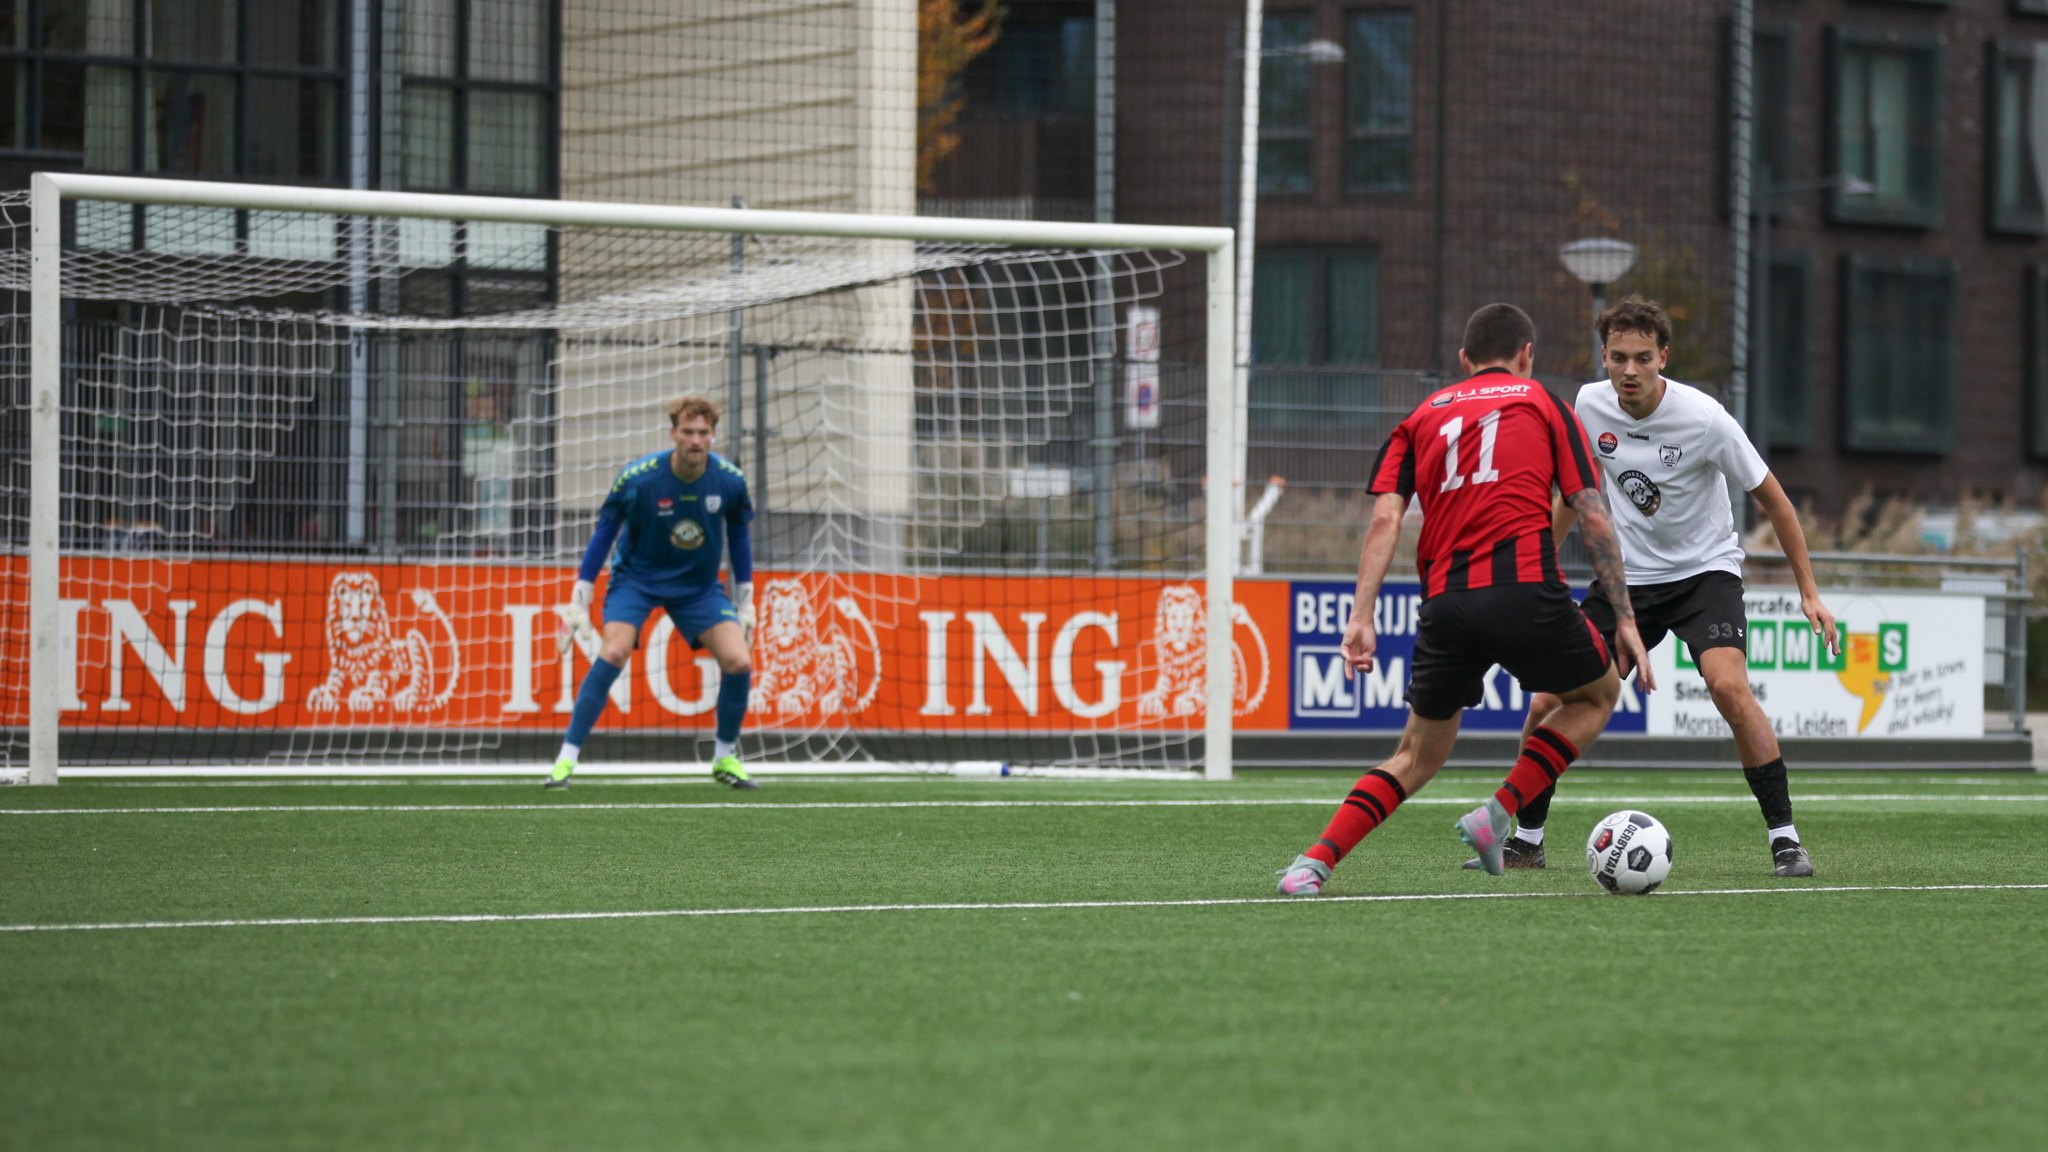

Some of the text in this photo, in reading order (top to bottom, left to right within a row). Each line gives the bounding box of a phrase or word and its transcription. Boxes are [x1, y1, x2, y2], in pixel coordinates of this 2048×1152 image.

[1479, 383, 1532, 396] SPORT
[1439, 409, 1501, 493] 11
[58, 598, 291, 713] ING
[1708, 622, 1733, 639] 33
[919, 610, 1127, 719] ING
[1796, 711, 1848, 737] Leiden
[1604, 824, 1638, 875] DERBYSTAR
